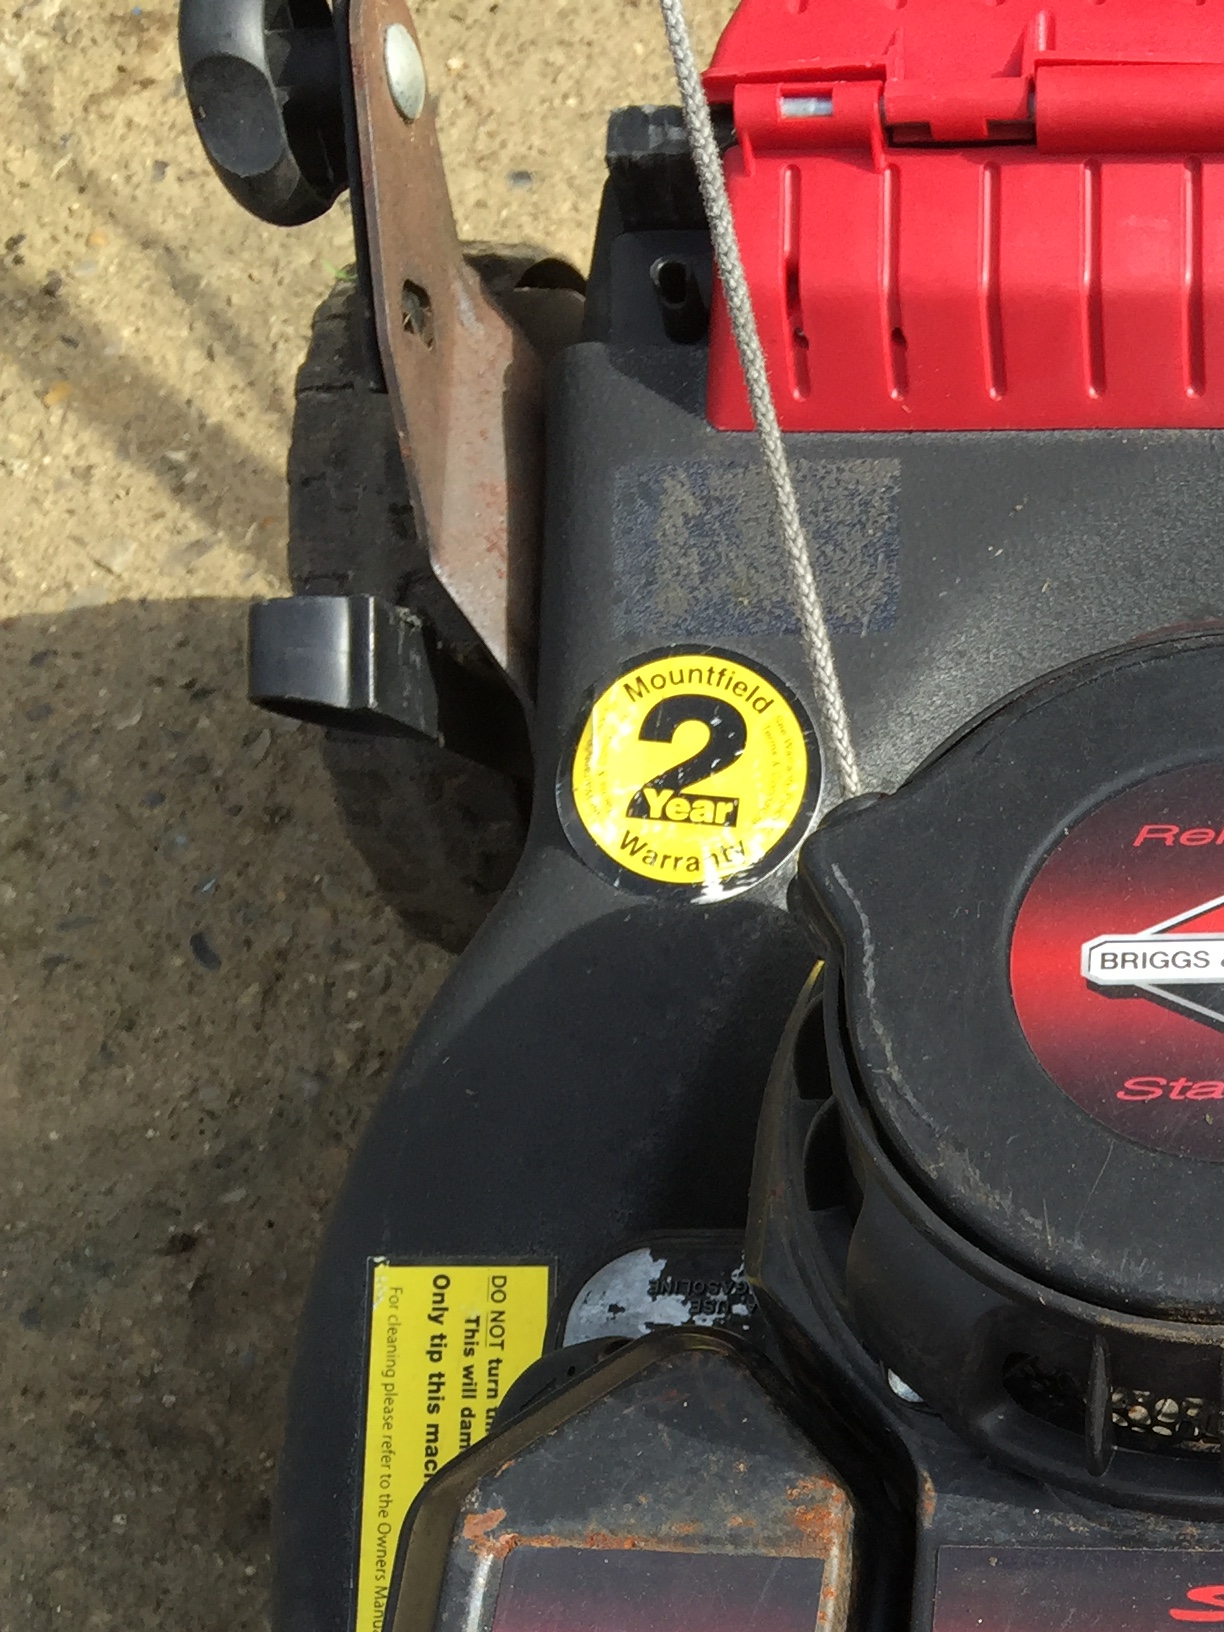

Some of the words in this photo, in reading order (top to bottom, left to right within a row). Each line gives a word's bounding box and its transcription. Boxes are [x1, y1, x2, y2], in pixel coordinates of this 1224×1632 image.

[623, 665, 774, 714] Mountfield
[626, 693, 748, 827] 2
[642, 787, 734, 825] Year
[1100, 949, 1212, 971] BRIGGS
[388, 1287, 403, 1310] For
[427, 1274, 451, 1326] Only
[489, 1275, 507, 1304] DO
[381, 1314, 402, 1378] cleaning
[425, 1332, 448, 1363] tip
[463, 1315, 481, 1358] This
[488, 1310, 506, 1350] NOT
[426, 1371, 446, 1415] this
[461, 1364, 478, 1400] will
[486, 1357, 503, 1399] turn
[381, 1383, 399, 1431] please
[459, 1406, 476, 1451] dam
[380, 1434, 396, 1471] refer
[379, 1473, 394, 1490] to
[378, 1492, 394, 1519] the
[374, 1522, 392, 1581] Owners
